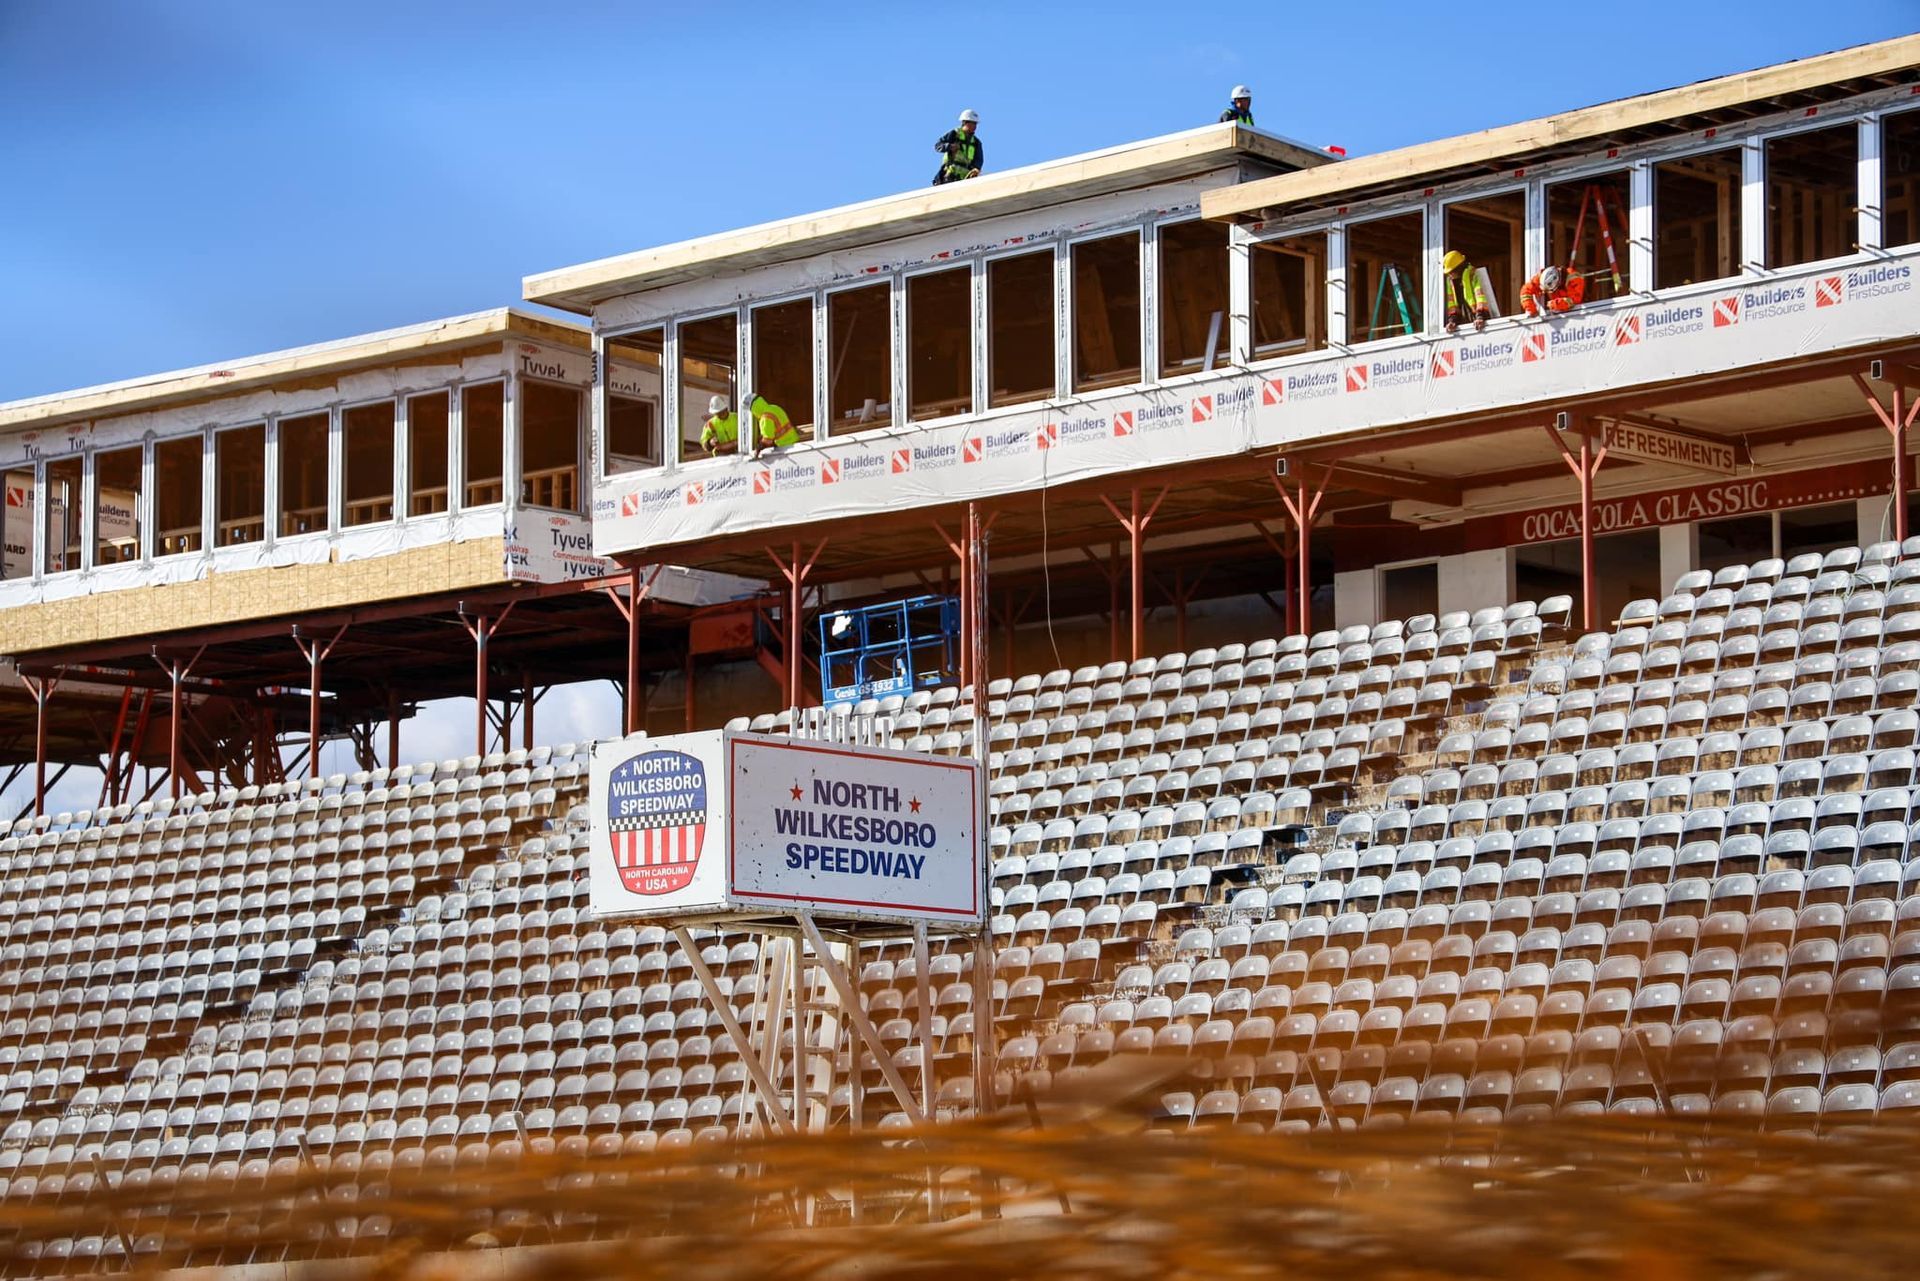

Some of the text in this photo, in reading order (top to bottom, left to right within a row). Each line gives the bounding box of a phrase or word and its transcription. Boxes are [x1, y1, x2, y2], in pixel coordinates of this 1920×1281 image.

[1848, 265, 1910, 288] Builders
[1745, 287, 1805, 309] Builders
[1849, 281, 1911, 301] FirstSource
[1646, 306, 1703, 327] Builders
[1745, 302, 1805, 321] FirstSource
[1551, 325, 1606, 345] Builders
[1645, 321, 1703, 340] FirstSource
[1460, 342, 1512, 361] Builders
[1551, 340, 1606, 358] FirstSource
[1373, 358, 1424, 376] Builders
[1460, 357, 1513, 374] FirstSource
[1288, 372, 1337, 390] Builders
[1373, 372, 1424, 388] FirstSource
[1288, 386, 1338, 401] FirstSource
[1138, 404, 1184, 421] Builders
[1061, 418, 1106, 434] Builders
[914, 444, 956, 460] Builders
[1605, 427, 1733, 468] REFRESHMENTS
[843, 454, 885, 470] Builders
[775, 465, 815, 481] Builders
[99, 504, 130, 518] uilders
[594, 499, 615, 510] lders
[1656, 481, 1769, 523] CLASSIC
[551, 528, 593, 551] Tyvek
[634, 756, 680, 775] NORTH
[612, 773, 701, 797] WILKESBORO
[621, 793, 695, 815] SPEEDWAY
[813, 779, 899, 812] NORTH
[775, 808, 936, 848] WILKESBORO
[786, 842, 925, 879] SPEEDWAY
[626, 867, 689, 879] NORTH CAROLINA
[646, 879, 668, 890] USA
